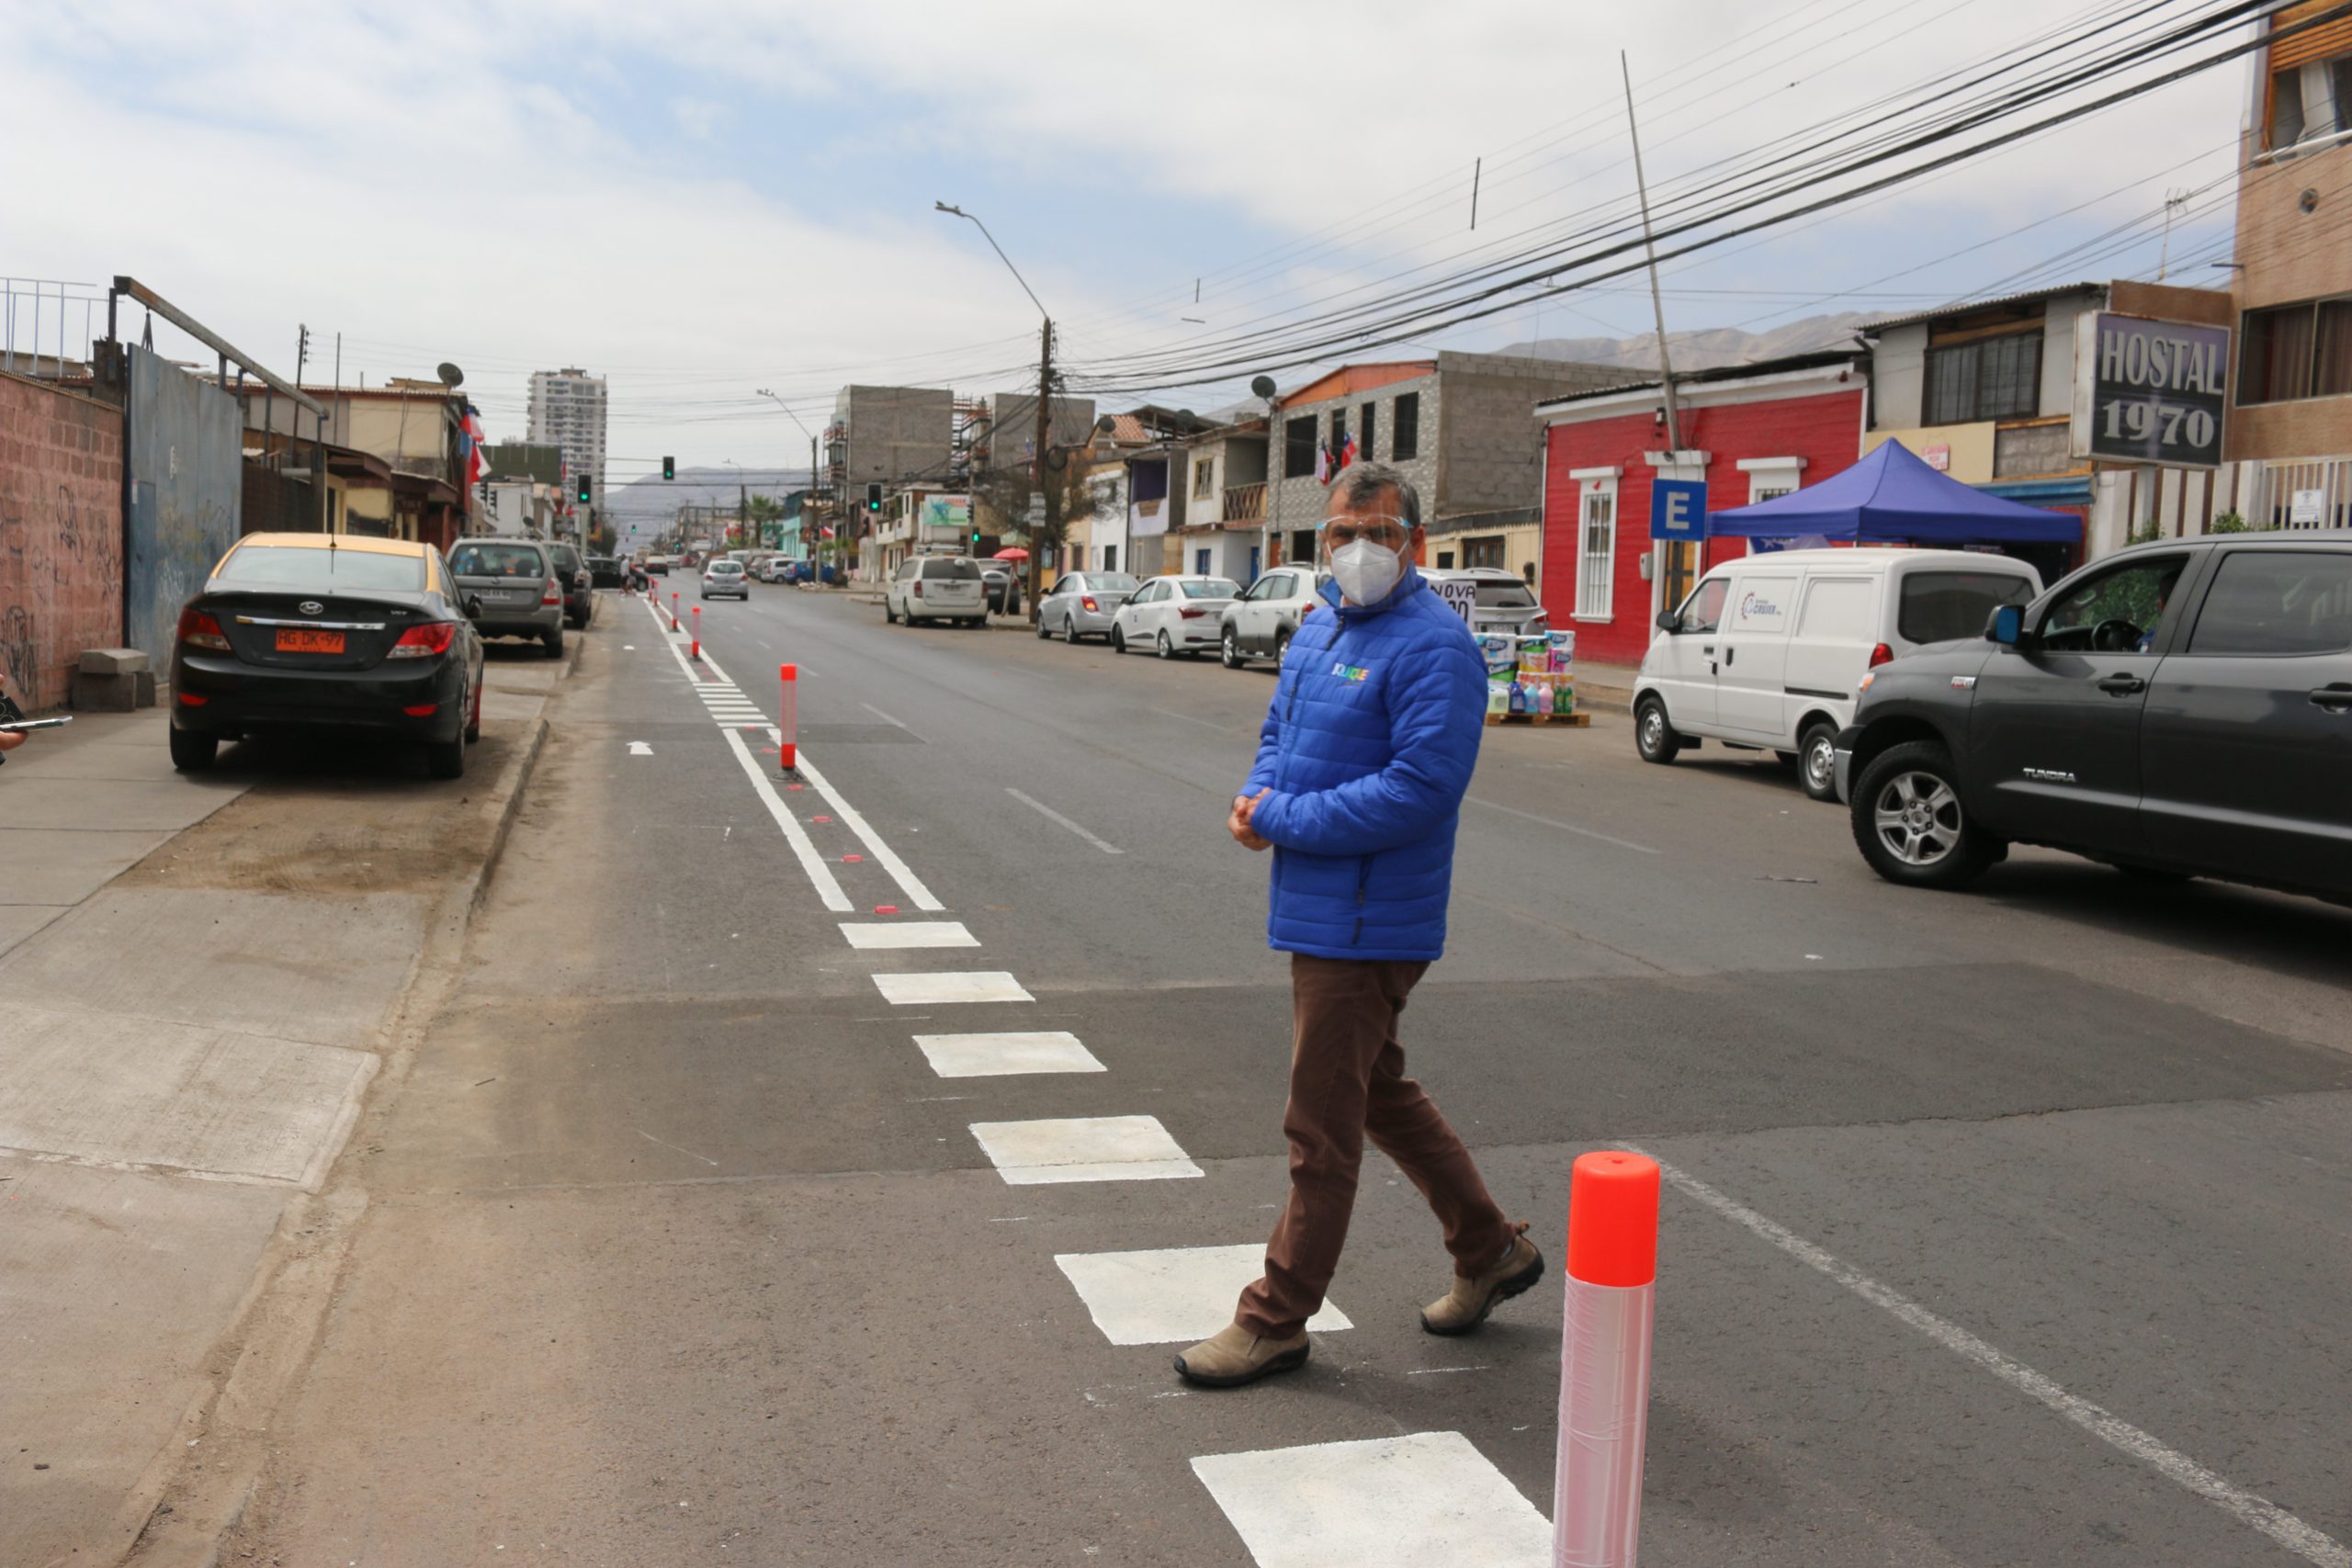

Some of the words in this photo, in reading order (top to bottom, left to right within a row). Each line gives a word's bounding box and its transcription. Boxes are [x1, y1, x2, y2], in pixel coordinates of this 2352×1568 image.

[2101, 330, 2224, 396] HOSTAL
[2102, 399, 2215, 448] 1970
[1666, 491, 1690, 530] E
[2023, 767, 2076, 783] TUNDRA
